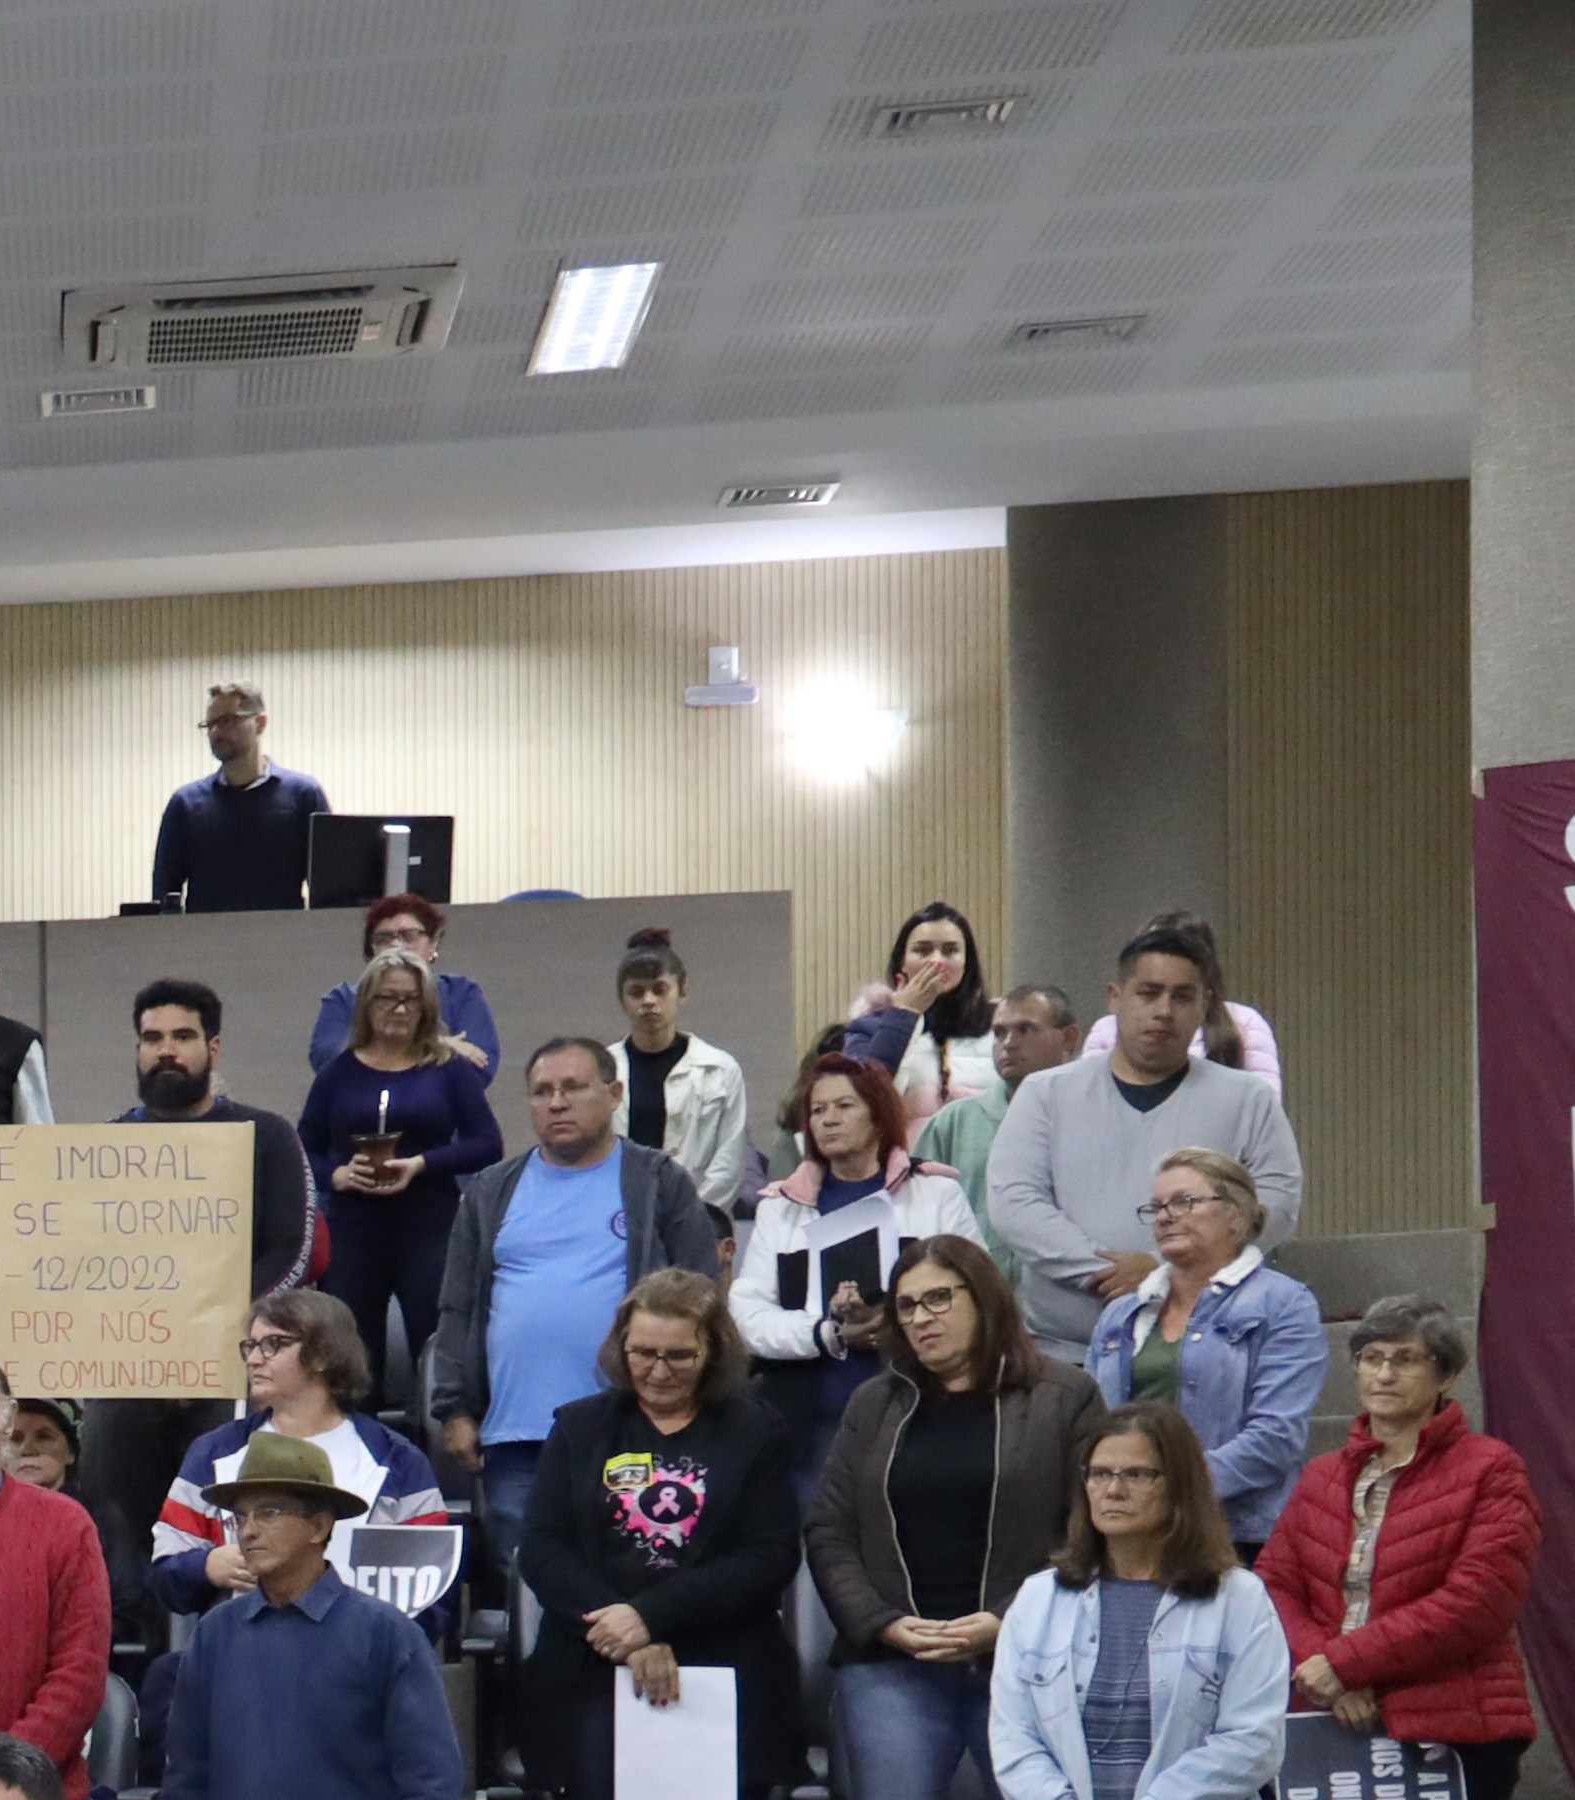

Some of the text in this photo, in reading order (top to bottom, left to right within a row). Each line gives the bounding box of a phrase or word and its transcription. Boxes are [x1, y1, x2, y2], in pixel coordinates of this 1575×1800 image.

[55, 1143, 208, 1182] IMORAL
[13, 1200, 62, 1237] SE
[91, 1196, 241, 1236] TORNAR
[10, 1309, 74, 1345] POR
[100, 1299, 172, 1345] NÓS
[1417, 1772, 1449, 1786] A
